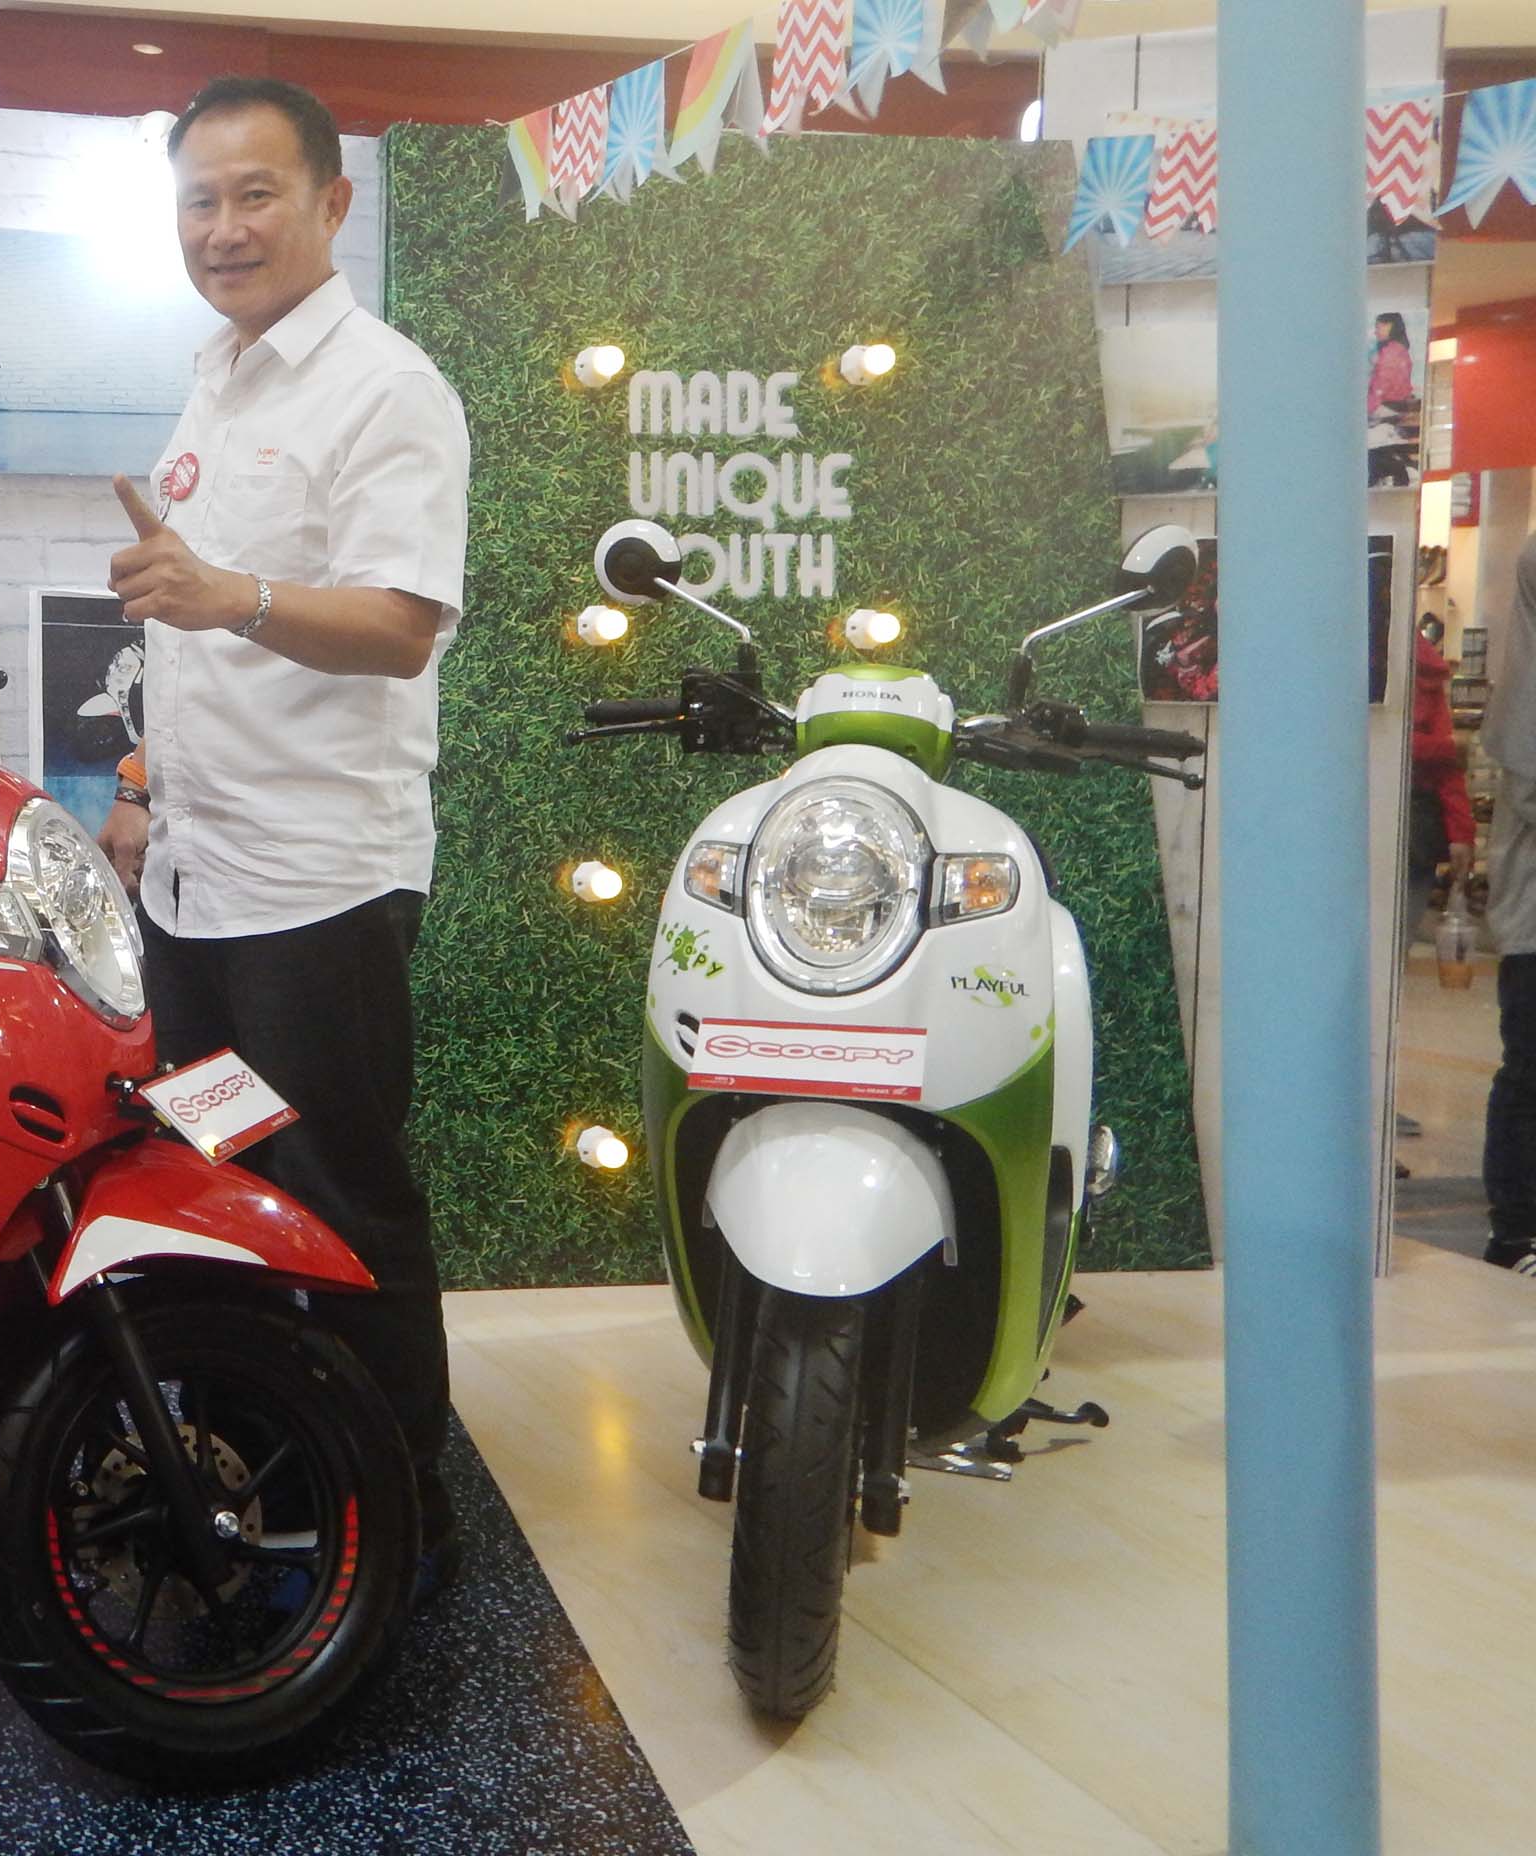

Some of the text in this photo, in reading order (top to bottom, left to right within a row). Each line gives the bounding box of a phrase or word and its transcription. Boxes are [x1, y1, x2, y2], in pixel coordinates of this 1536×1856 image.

[629, 370, 800, 437] MADE
[629, 451, 853, 530] UNIQUE
[673, 532, 835, 599] OUTH
[841, 689, 903, 702] HONDA
[951, 975, 1031, 998] PLAYFUL
[705, 1034, 914, 1065] SCOOPY
